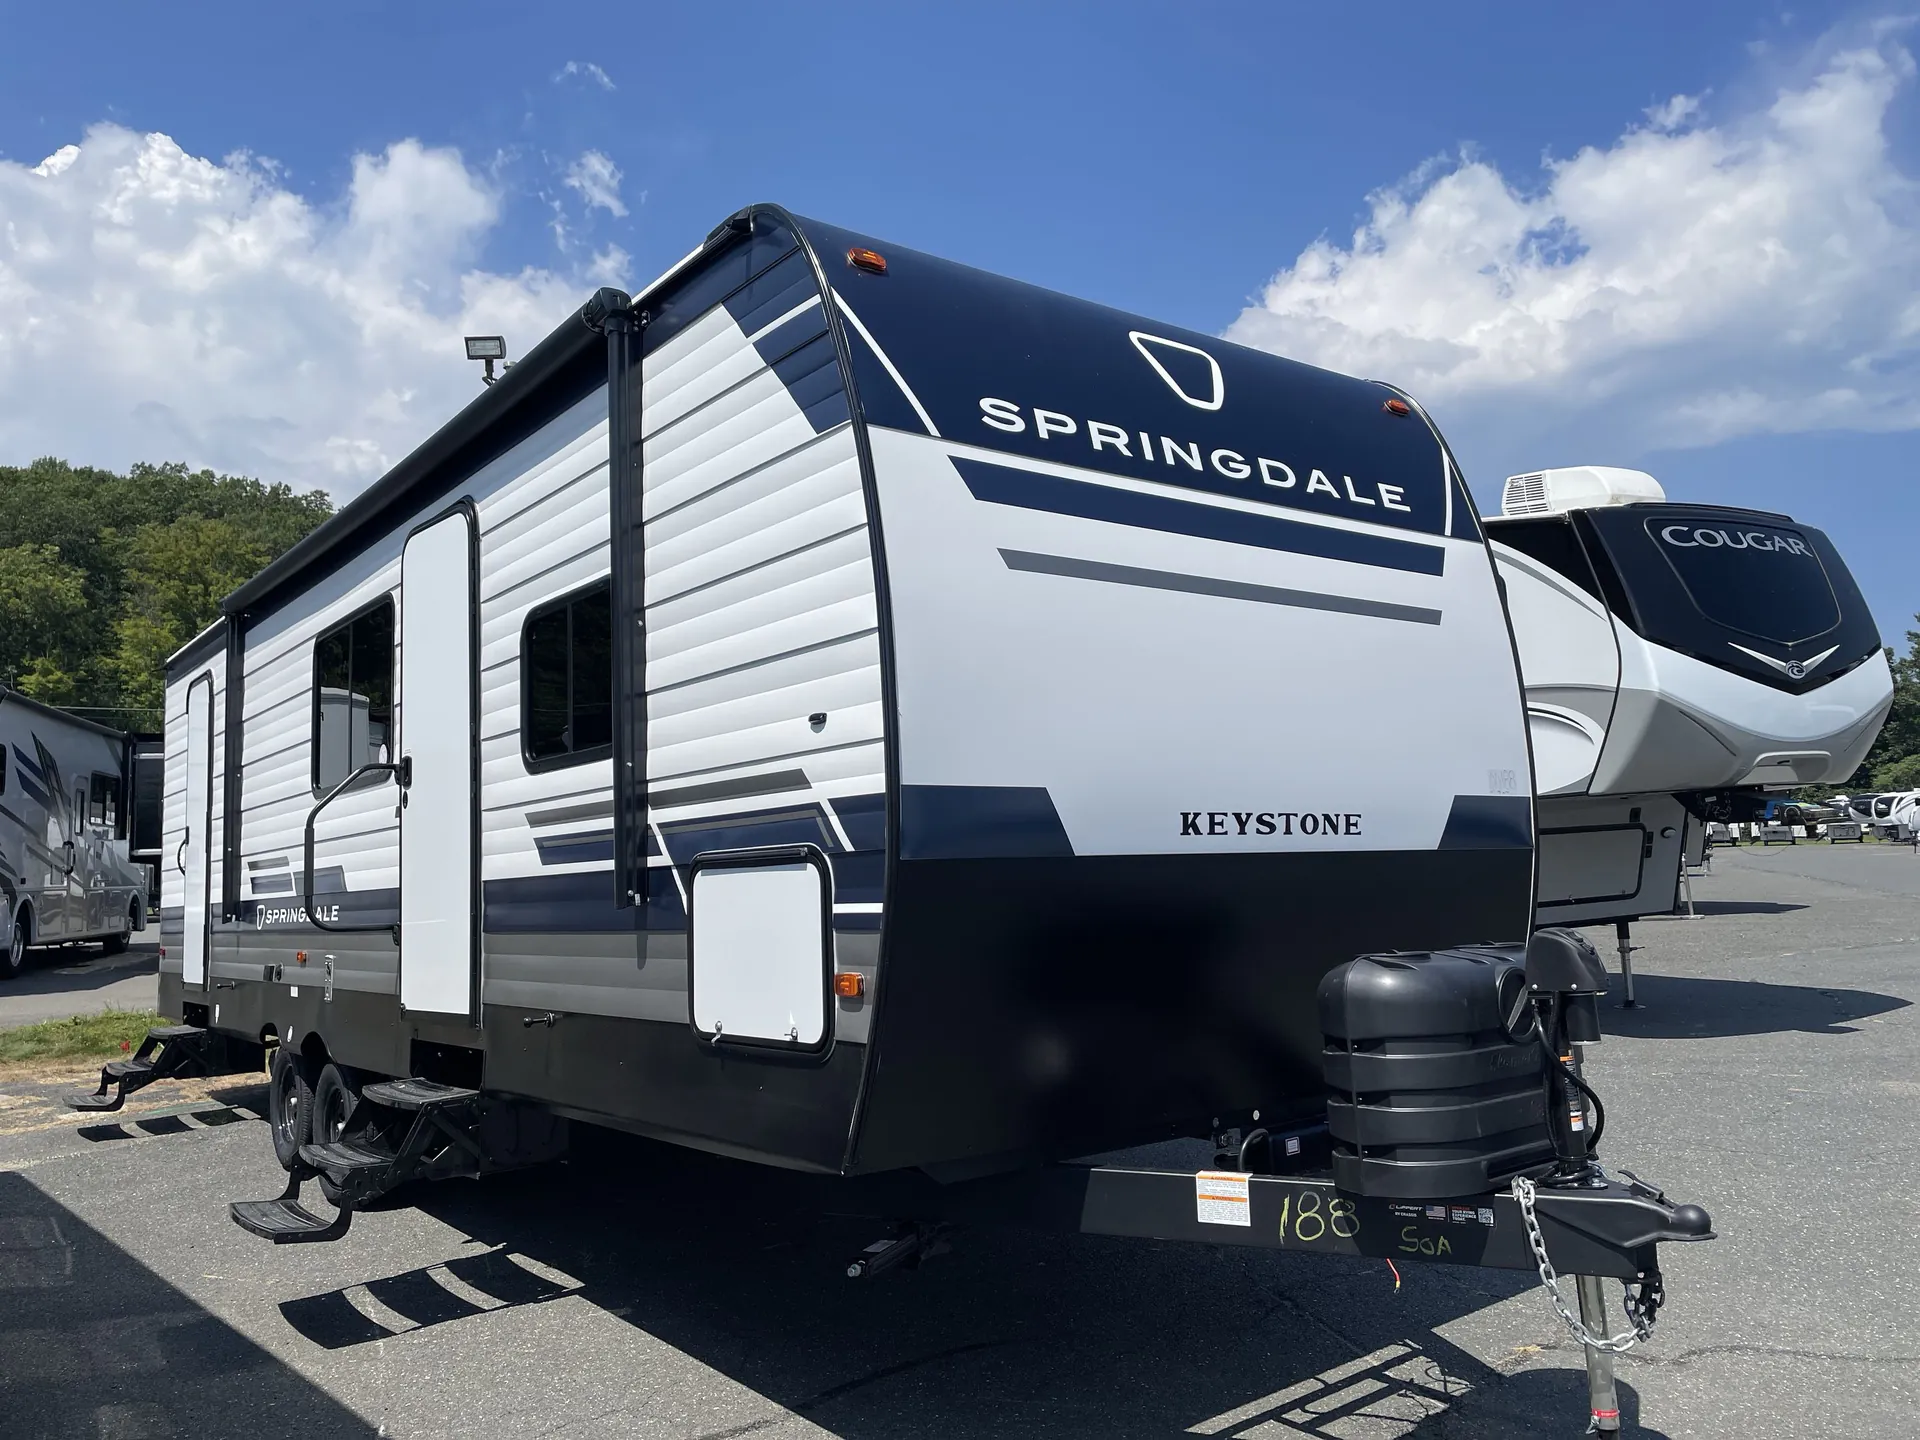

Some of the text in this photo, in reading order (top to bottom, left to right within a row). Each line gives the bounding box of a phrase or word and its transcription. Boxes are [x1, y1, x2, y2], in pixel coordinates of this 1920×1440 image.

[979, 397, 1412, 513] SPRINGDALE
[1661, 525, 1814, 558] COUGAR
[1179, 811, 1362, 836] KEYSTONE
[1279, 1191, 1360, 1245] 188
